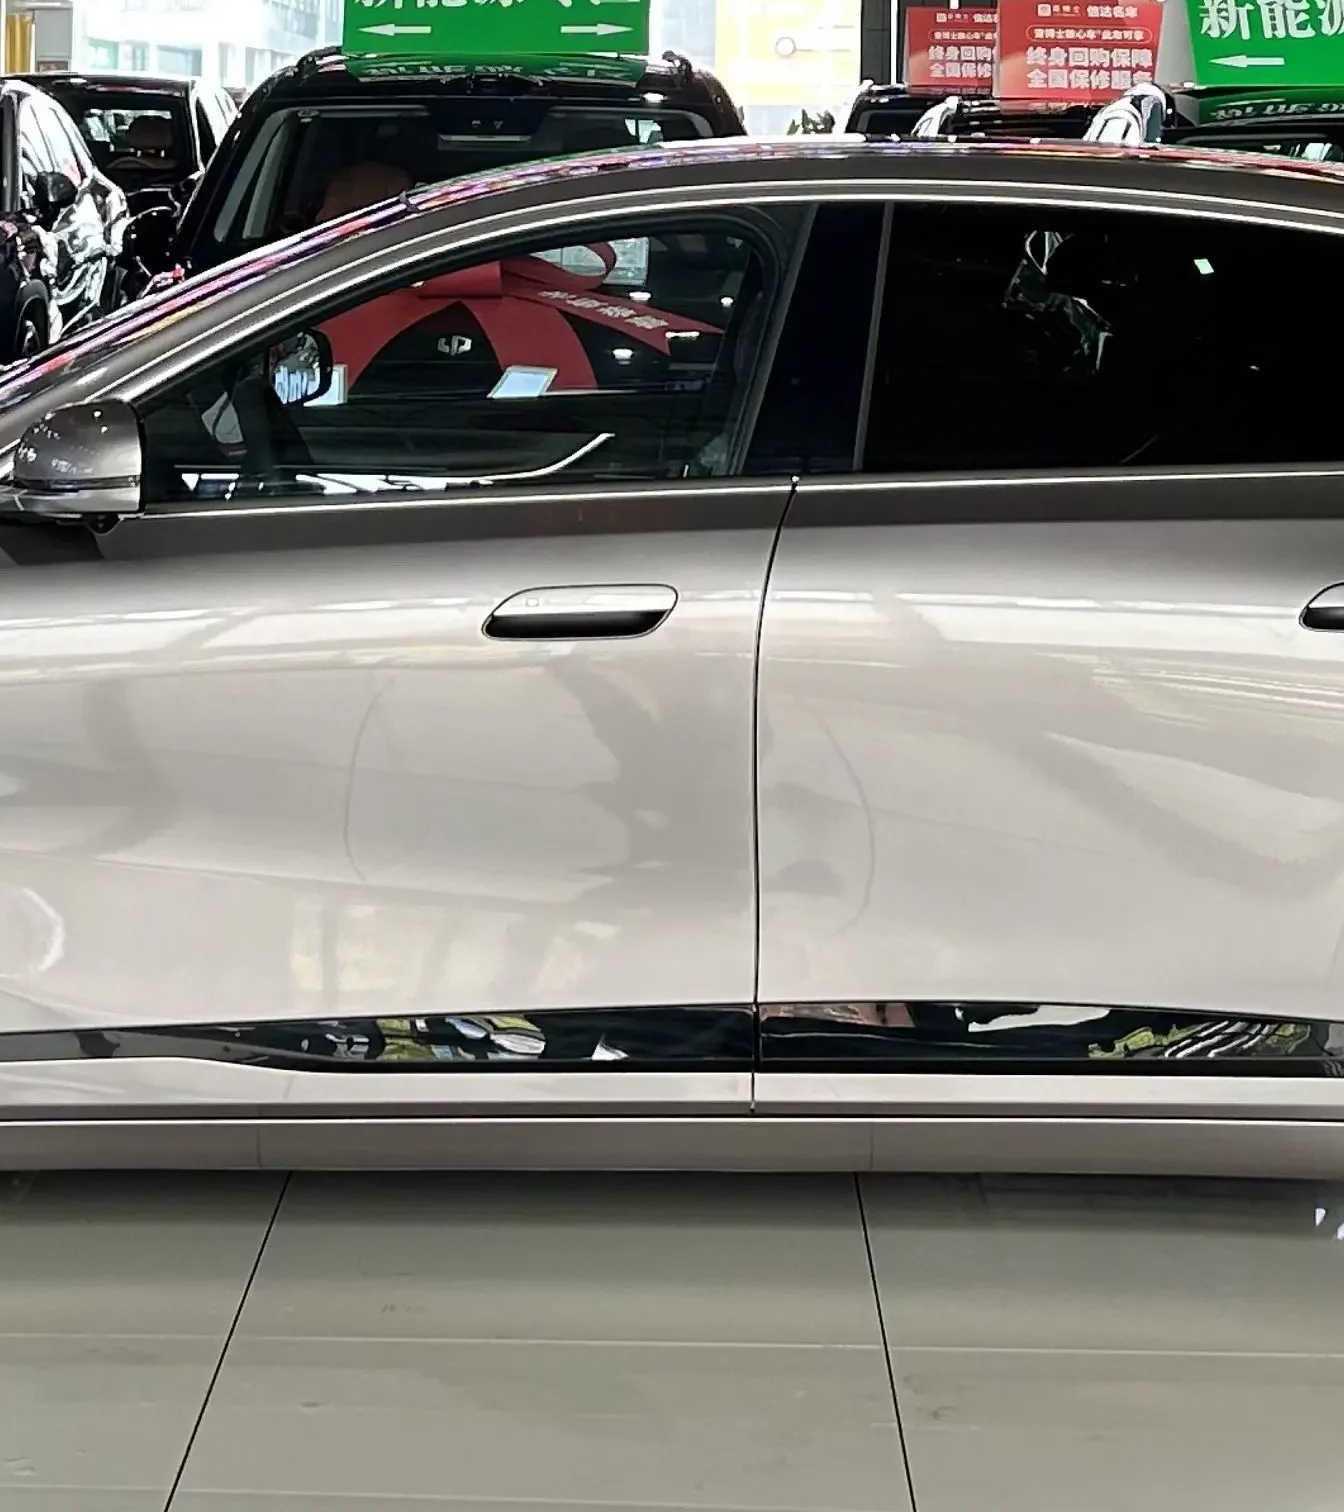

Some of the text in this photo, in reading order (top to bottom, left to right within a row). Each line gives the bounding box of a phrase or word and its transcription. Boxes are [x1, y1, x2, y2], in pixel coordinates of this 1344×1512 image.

[928, 46, 998, 61] 终身回购
[1026, 46, 1153, 68] 终身回购保障
